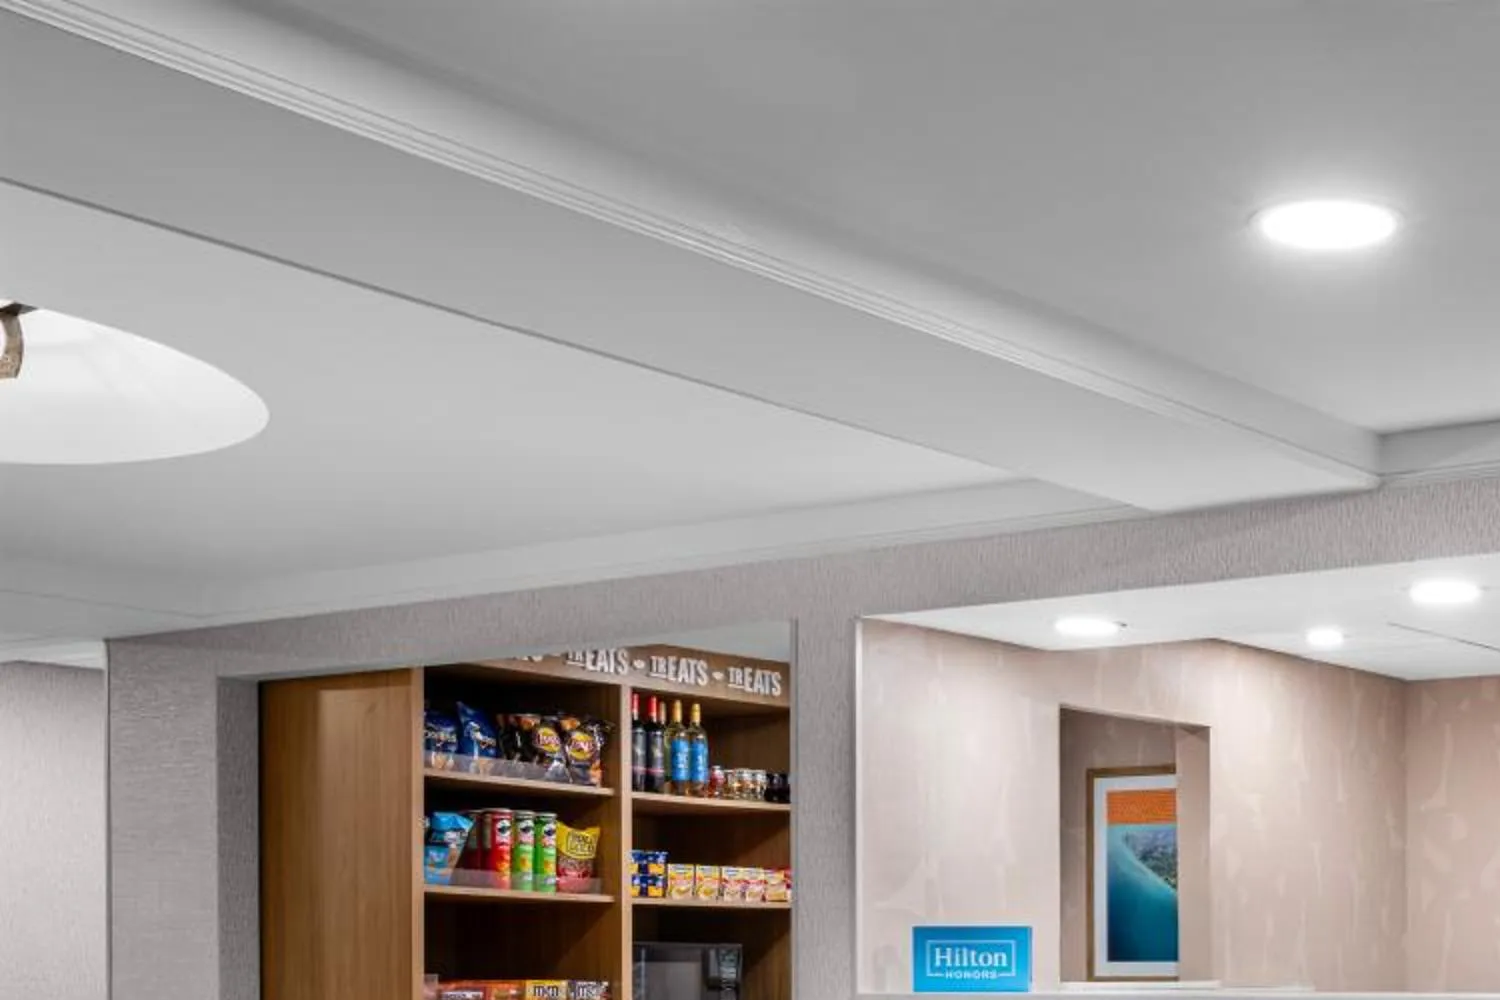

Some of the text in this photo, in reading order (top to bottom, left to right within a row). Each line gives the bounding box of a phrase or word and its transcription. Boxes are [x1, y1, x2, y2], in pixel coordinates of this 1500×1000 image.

[650, 655, 709, 686] TREATS
[727, 667, 782, 696] TREATS
[934, 947, 1008, 967] Hilton
[945, 970, 998, 980] HONORS
